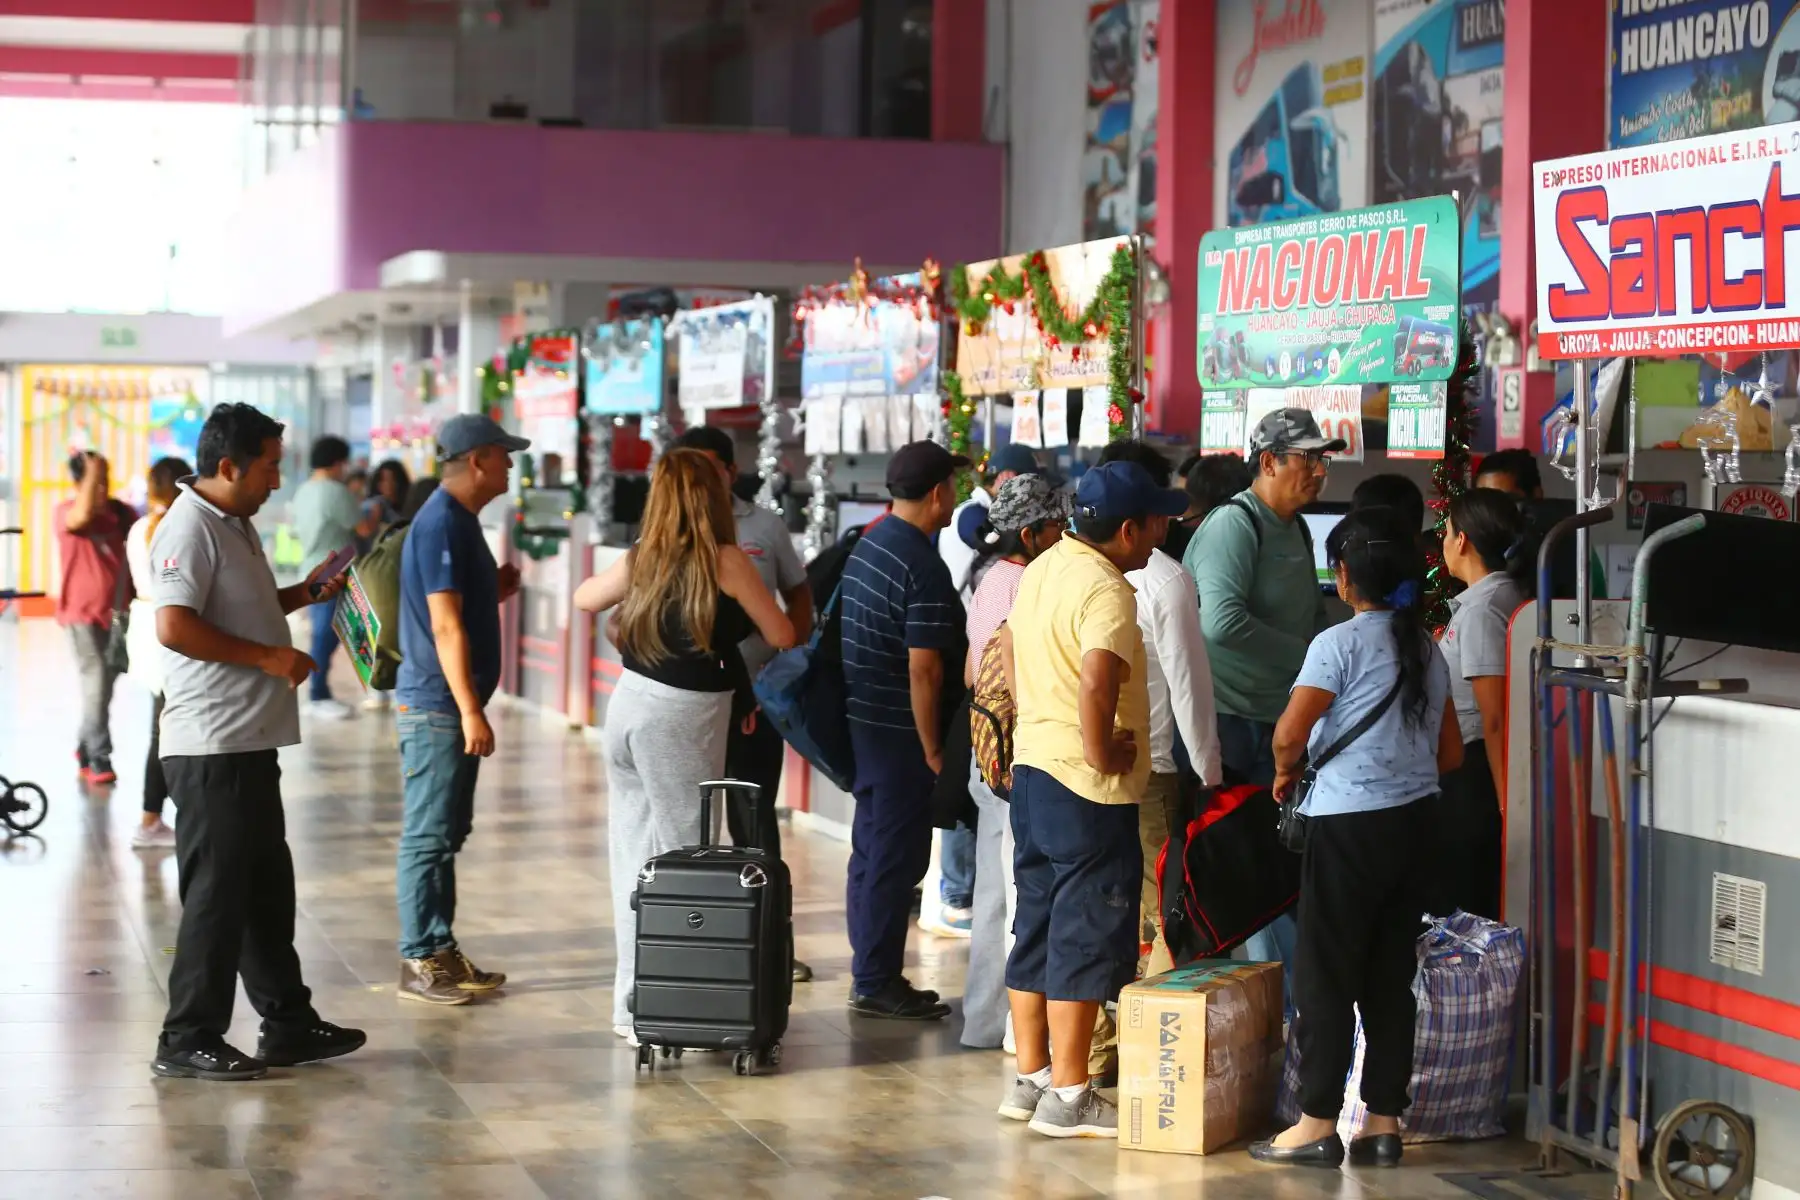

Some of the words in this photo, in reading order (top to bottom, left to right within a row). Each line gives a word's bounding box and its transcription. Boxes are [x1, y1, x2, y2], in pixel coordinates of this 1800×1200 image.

[1621, 1, 1769, 75] HUANCAYO
[1620, 103, 1661, 137] Uniendo
[1543, 164, 1603, 188] EXPRESO
[1607, 146, 1727, 179] INTERNACIONAL
[1731, 136, 1788, 161] E.I.R.L.
[1235, 228, 1263, 245] EMPRESA
[1263, 227, 1272, 241] DE
[1273, 220, 1318, 239] TRANSPORTES
[1320, 217, 1345, 232] CERRO
[1346, 214, 1357, 229] DE
[1358, 211, 1385, 227] PASCO
[1386, 208, 1408, 224] S.R.L.
[1216, 224, 1431, 316] NACIONAL
[1247, 311, 1298, 332] HUANCAYO
[1305, 307, 1337, 329] JAUJA
[1344, 303, 1396, 326] CHUPACA
[1560, 333, 1600, 354] OROYA
[1609, 330, 1651, 352] JAUJA
[1756, 321, 1800, 344] HUAN
[1390, 384, 1421, 394] EXPRESO
[1395, 393, 1430, 403] NACIONAL
[1505, 375, 1519, 410] S
